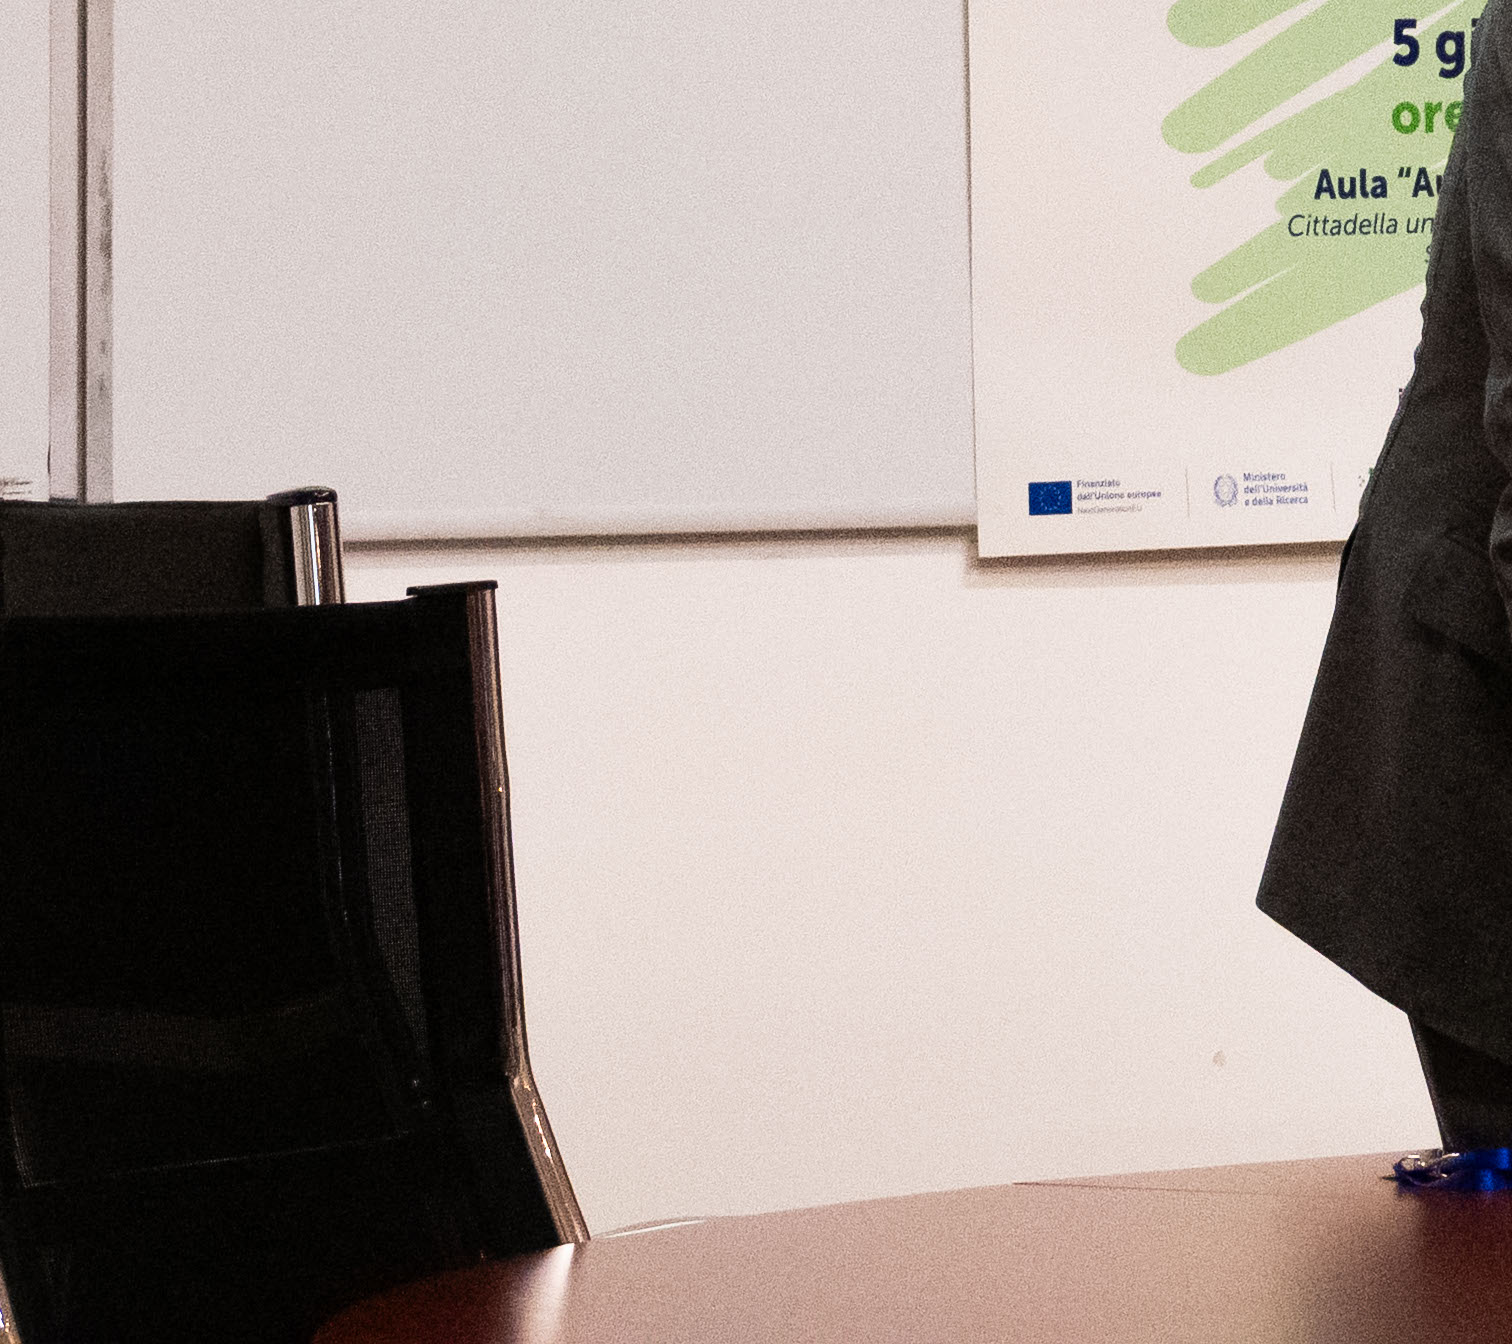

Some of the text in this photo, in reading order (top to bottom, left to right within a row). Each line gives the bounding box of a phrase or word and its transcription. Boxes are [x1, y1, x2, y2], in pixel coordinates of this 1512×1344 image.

[1392, 18, 1420, 67] 5
[1314, 168, 1388, 200] Aula
[1288, 213, 1398, 237] Cittadella
[1243, 472, 1286, 482] Ministero
[1252, 495, 1274, 506] della
[1276, 494, 1309, 505] Ricerca
